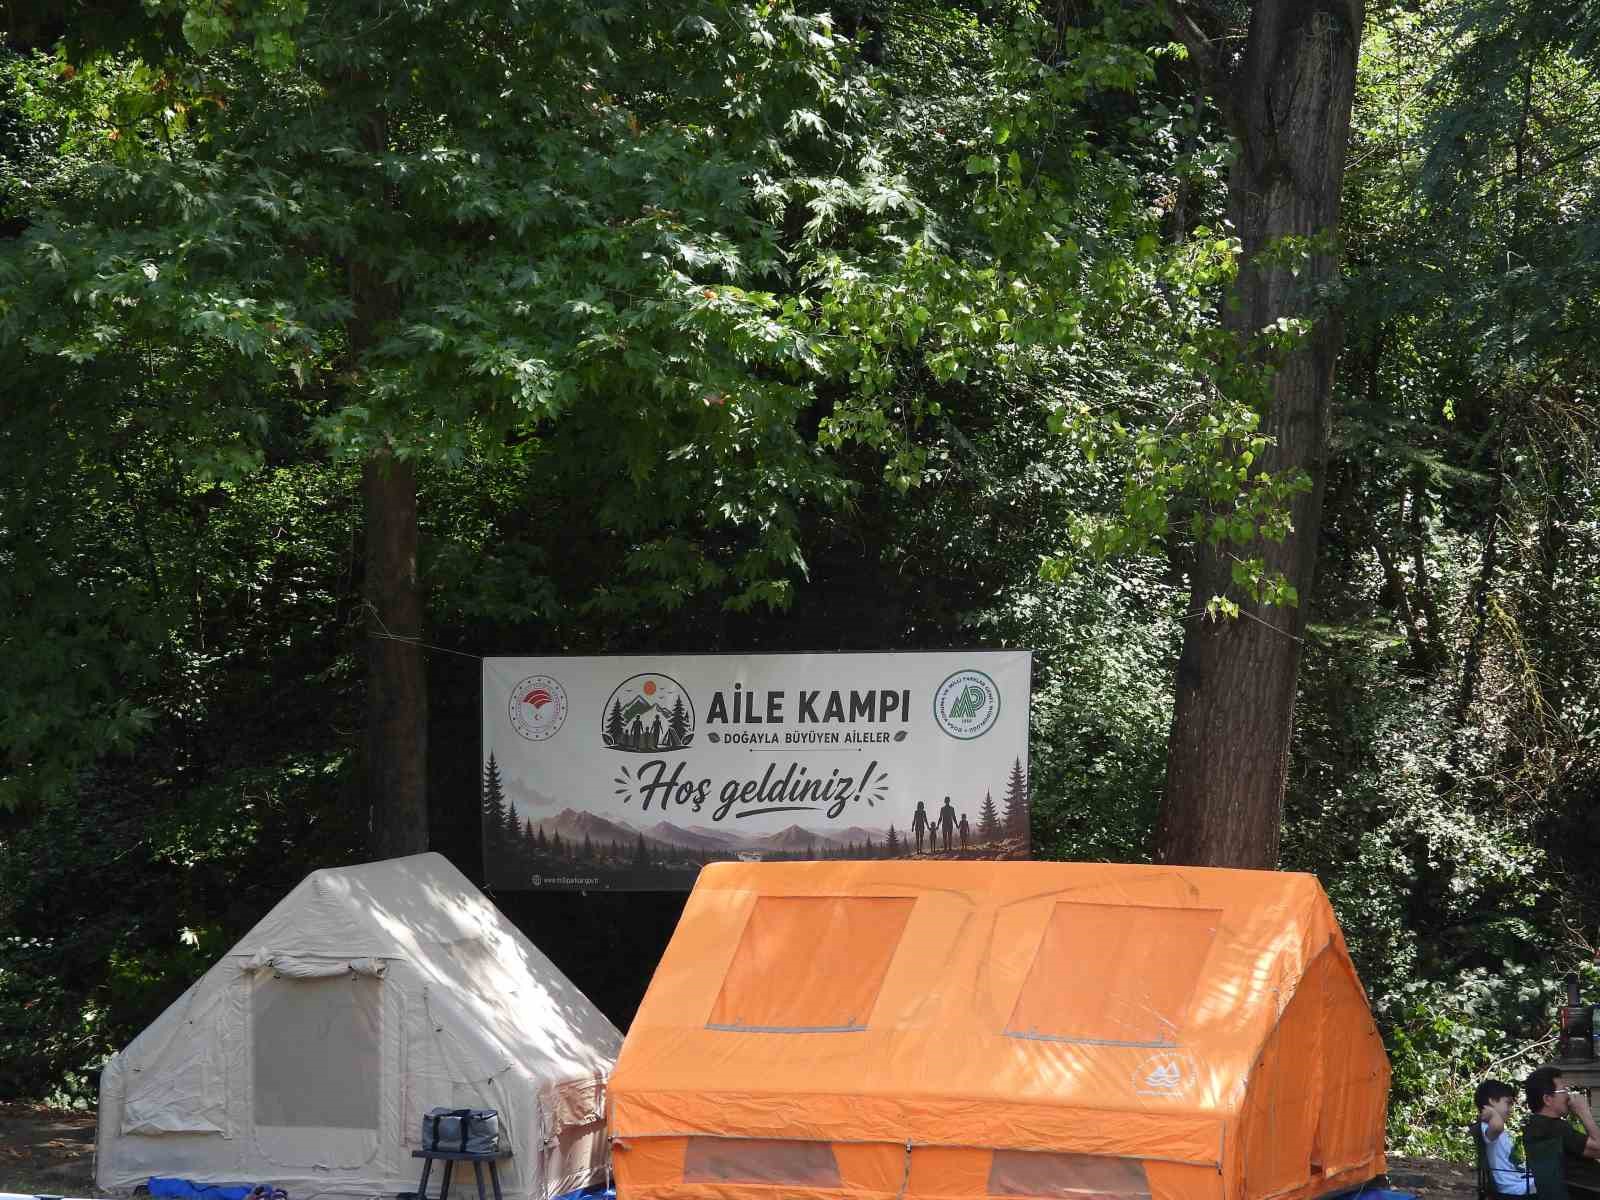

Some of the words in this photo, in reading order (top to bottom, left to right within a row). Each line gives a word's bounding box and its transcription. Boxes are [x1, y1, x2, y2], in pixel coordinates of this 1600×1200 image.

[706, 682, 785, 724] AİLE
[799, 689, 911, 723] KAMPI
[723, 730, 780, 744] DOĞAYLA
[785, 730, 839, 744] BÜYÜYEN
[844, 730, 891, 743] AİLELER
[636, 759, 712, 813] Hoş
[712, 760, 878, 822] geldiniz!
